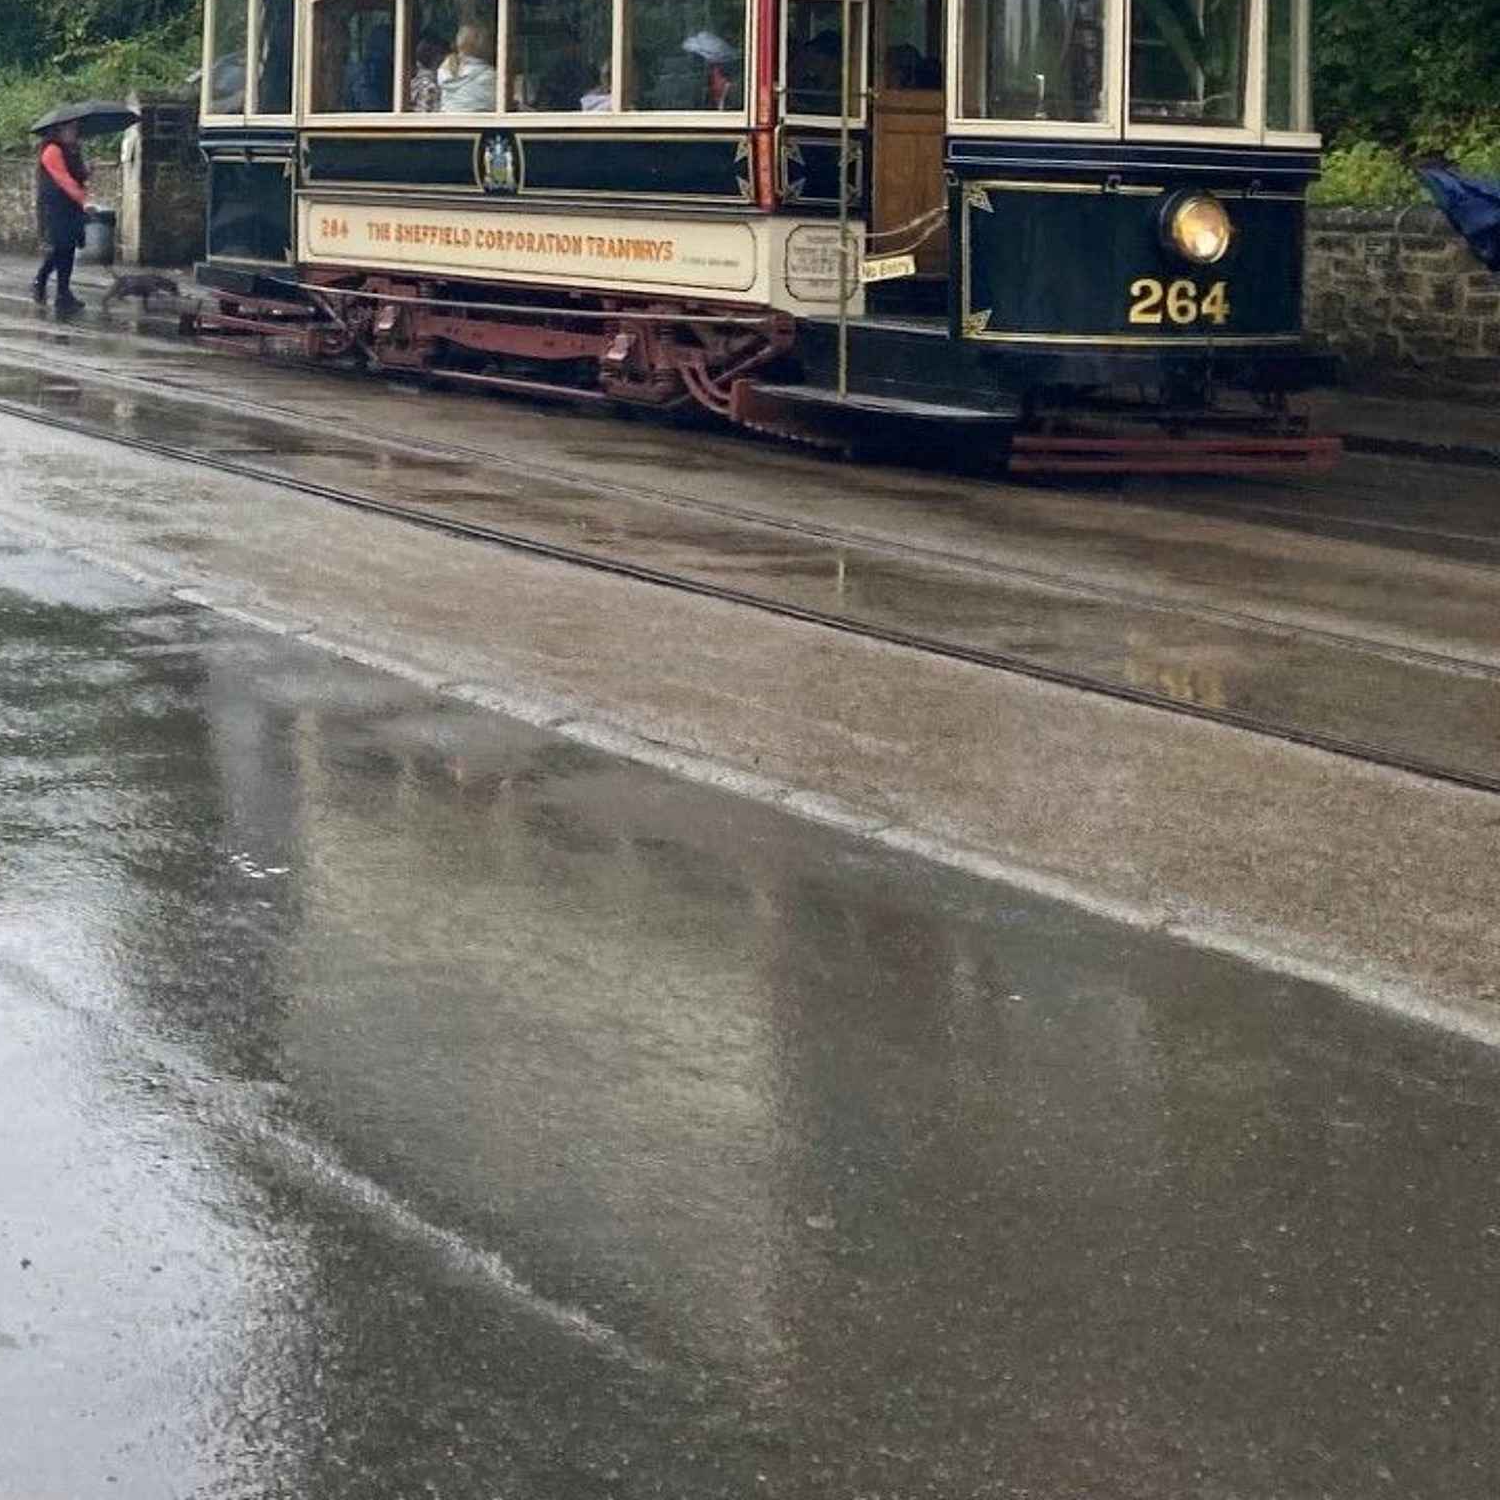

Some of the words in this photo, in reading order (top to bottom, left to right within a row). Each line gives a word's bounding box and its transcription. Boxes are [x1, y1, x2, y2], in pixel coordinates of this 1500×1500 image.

[367, 222, 392, 241] THE
[395, 223, 471, 248] SHEFFIELD
[475, 228, 582, 254] CORPORATION
[587, 236, 673, 262] TRAMWAYS
[1128, 278, 1230, 324] 264
